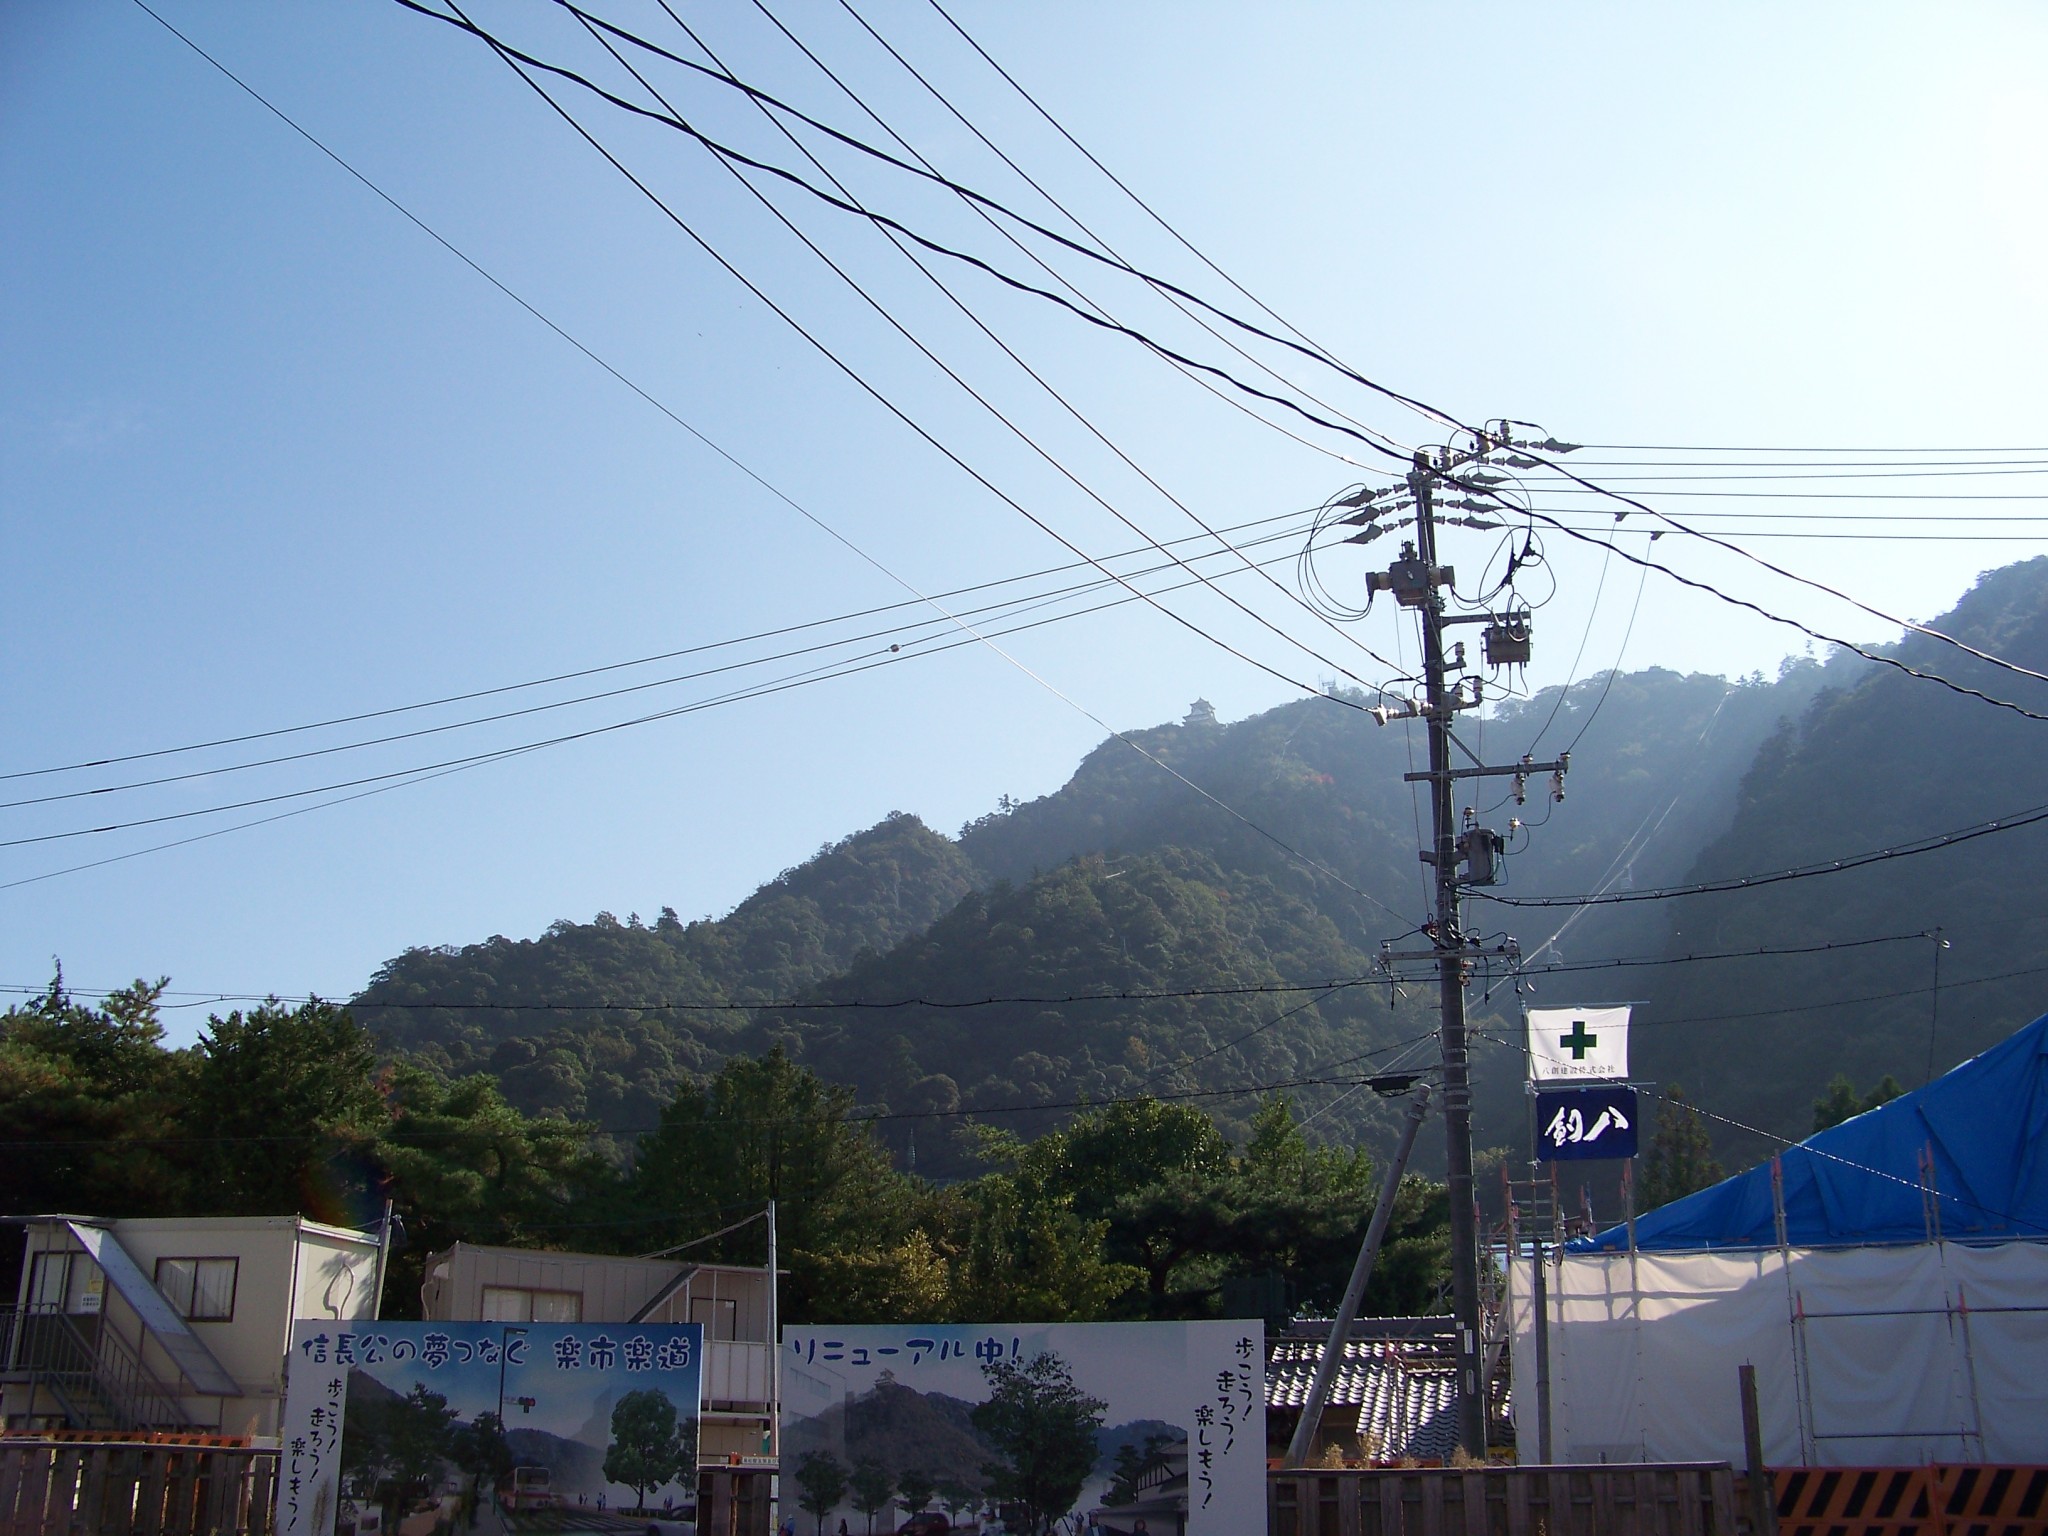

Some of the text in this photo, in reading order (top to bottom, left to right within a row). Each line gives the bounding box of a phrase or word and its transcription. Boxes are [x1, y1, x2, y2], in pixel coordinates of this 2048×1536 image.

[302, 1333, 692, 1371] 信長公の夢つなぐ 楽市楽道
[793, 1337, 1021, 1366] リニューアル中!
